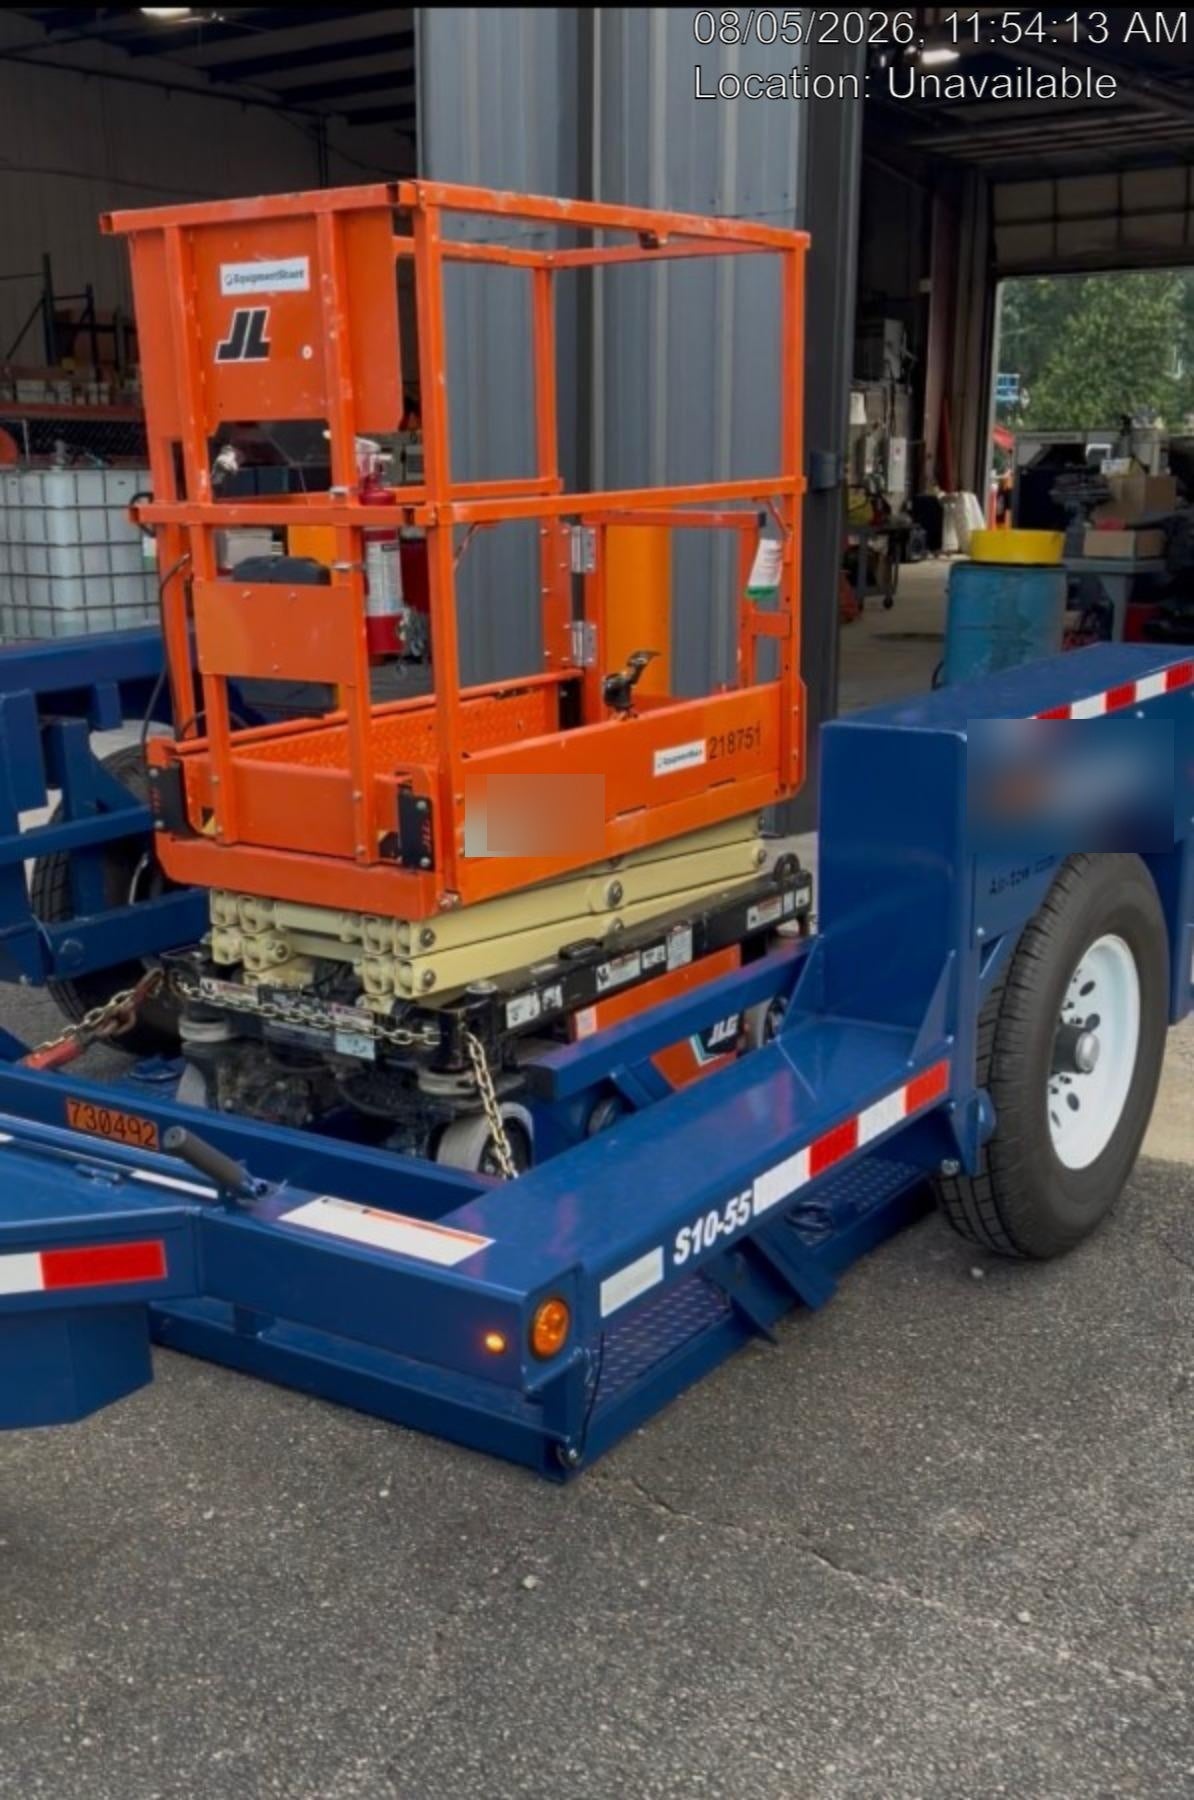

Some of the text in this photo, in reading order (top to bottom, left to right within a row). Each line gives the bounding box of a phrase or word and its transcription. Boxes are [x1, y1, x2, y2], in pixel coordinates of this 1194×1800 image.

[708, 721, 762, 761] 218751
[67, 1100, 158, 1150] 730492
[673, 1189, 752, 1265] S10-55
